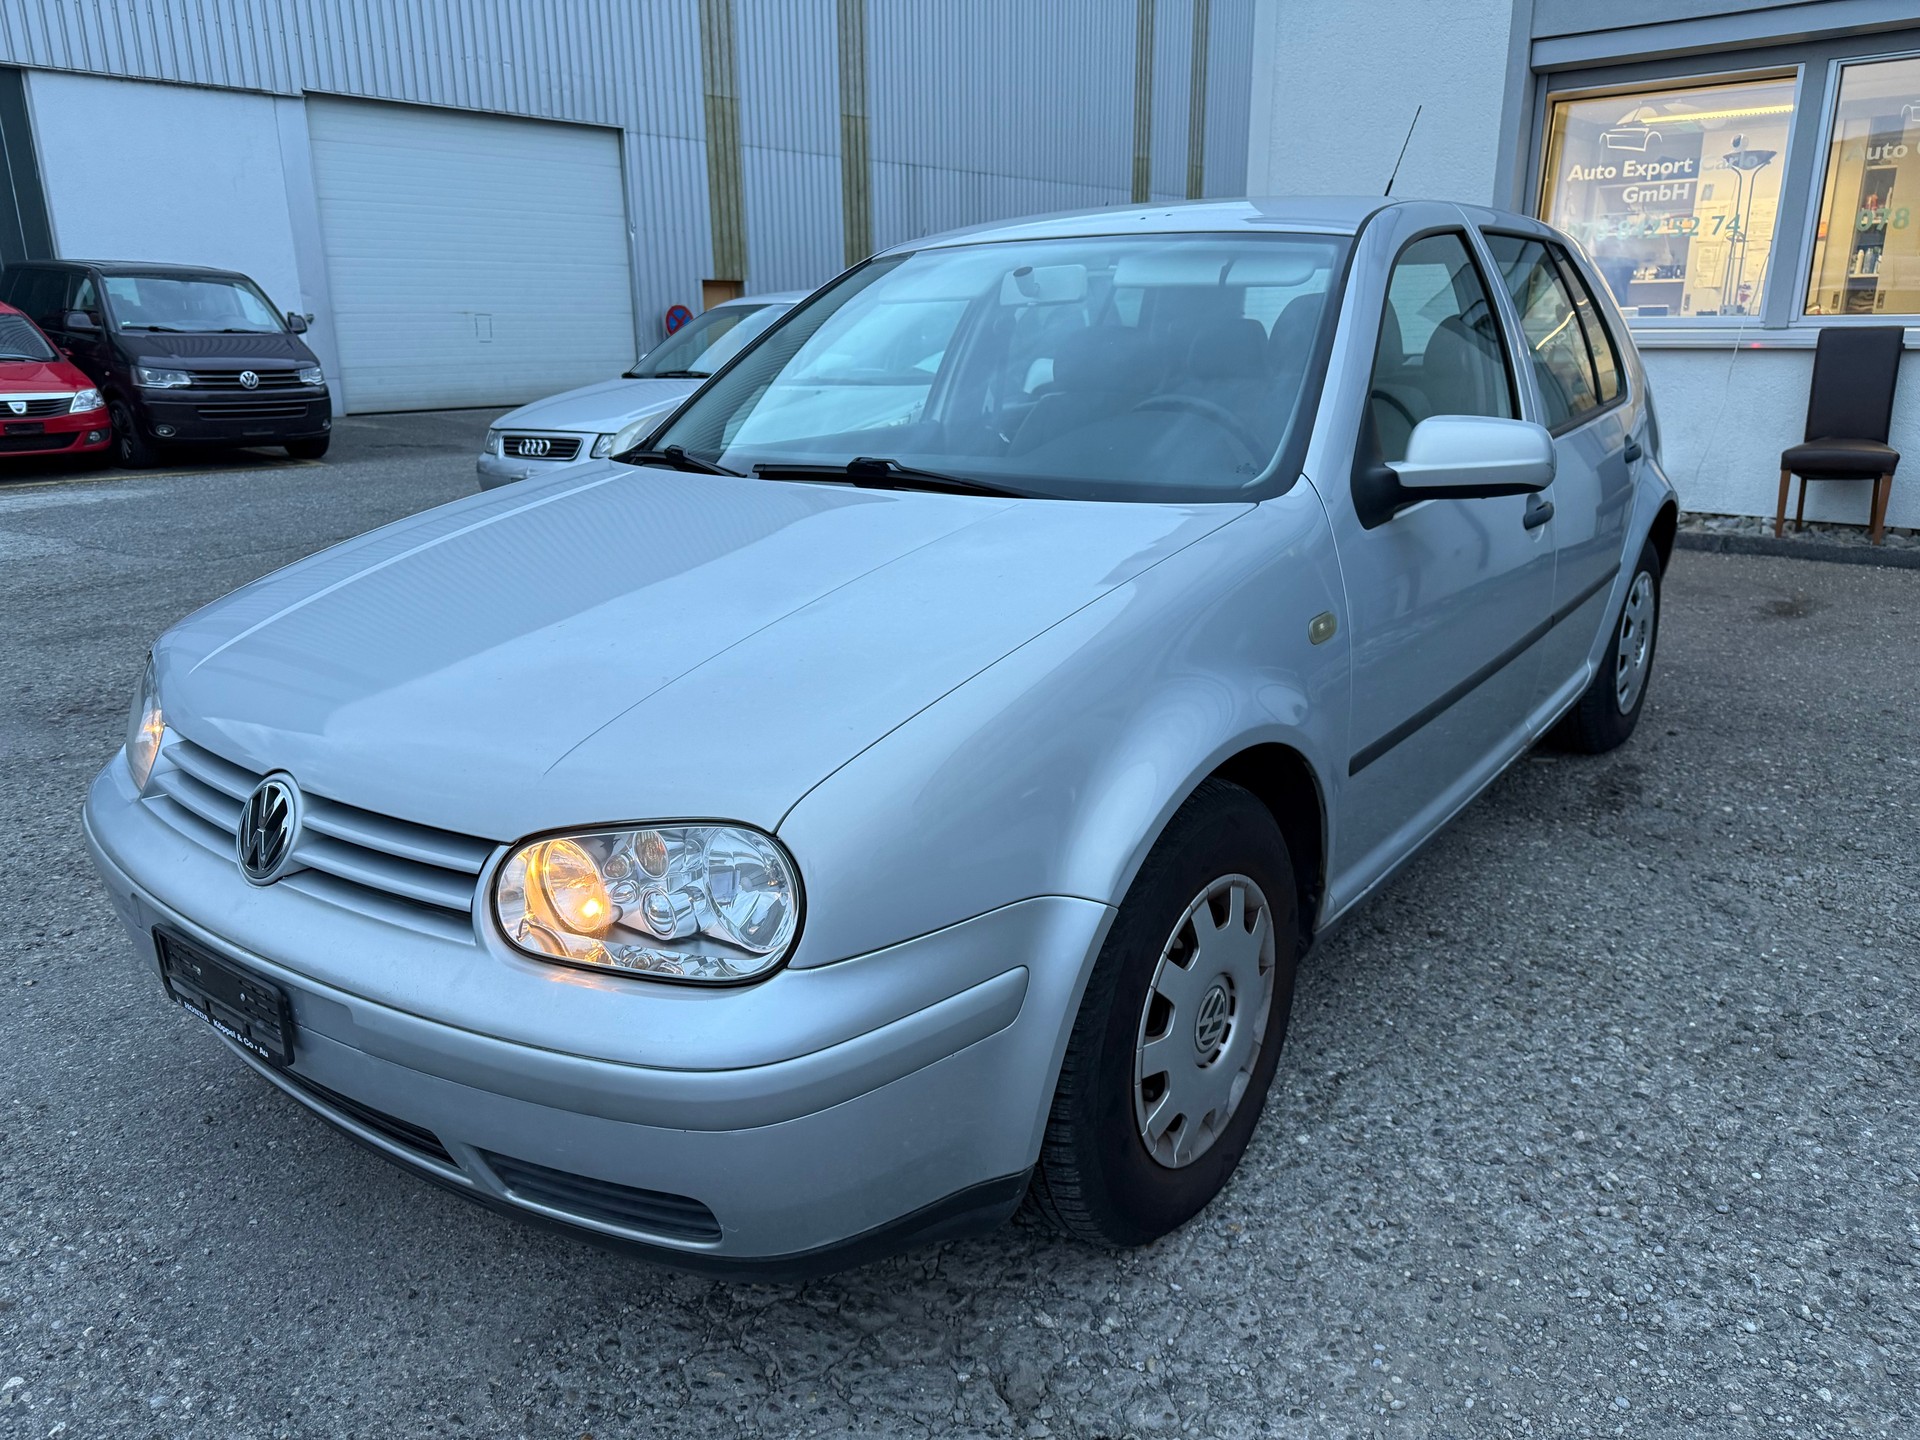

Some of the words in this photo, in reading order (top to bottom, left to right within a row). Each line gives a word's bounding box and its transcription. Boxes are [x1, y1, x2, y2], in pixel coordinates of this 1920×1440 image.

[1845, 142, 1908, 162] Auto
[1566, 164, 1616, 182] Auto
[1622, 157, 1693, 181] Export
[1622, 182, 1691, 203] GmbH
[1670, 215, 1700, 237] 52
[1711, 214, 1741, 236] 74
[1855, 207, 1910, 232] 078
[238, 782, 295, 880] VW
[183, 1001, 210, 1022] HONDA
[243, 1037, 254, 1049] Co
